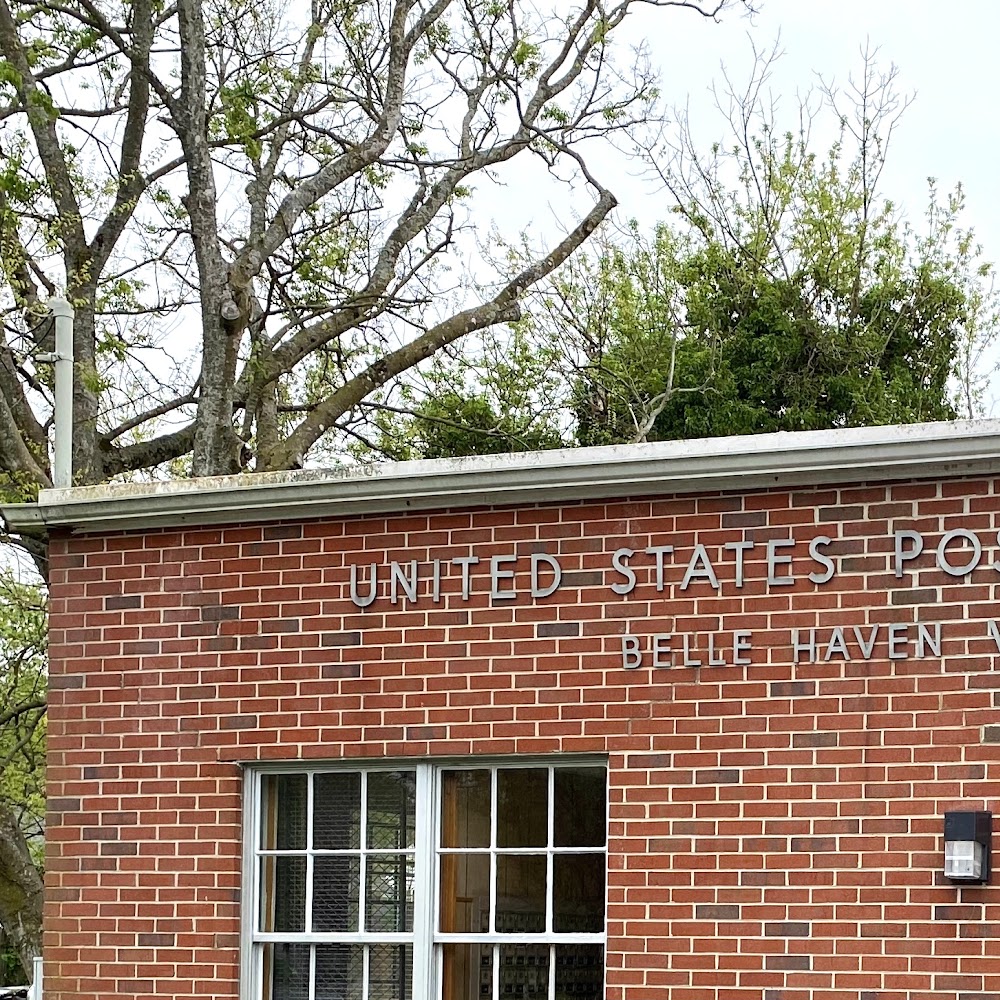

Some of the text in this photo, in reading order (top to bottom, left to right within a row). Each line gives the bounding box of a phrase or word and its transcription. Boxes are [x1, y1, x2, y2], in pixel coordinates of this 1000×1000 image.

[350, 553, 562, 607] UNITED
[610, 535, 836, 596] STATES
[621, 630, 753, 670] BELLE
[792, 622, 943, 664] HAVEN
